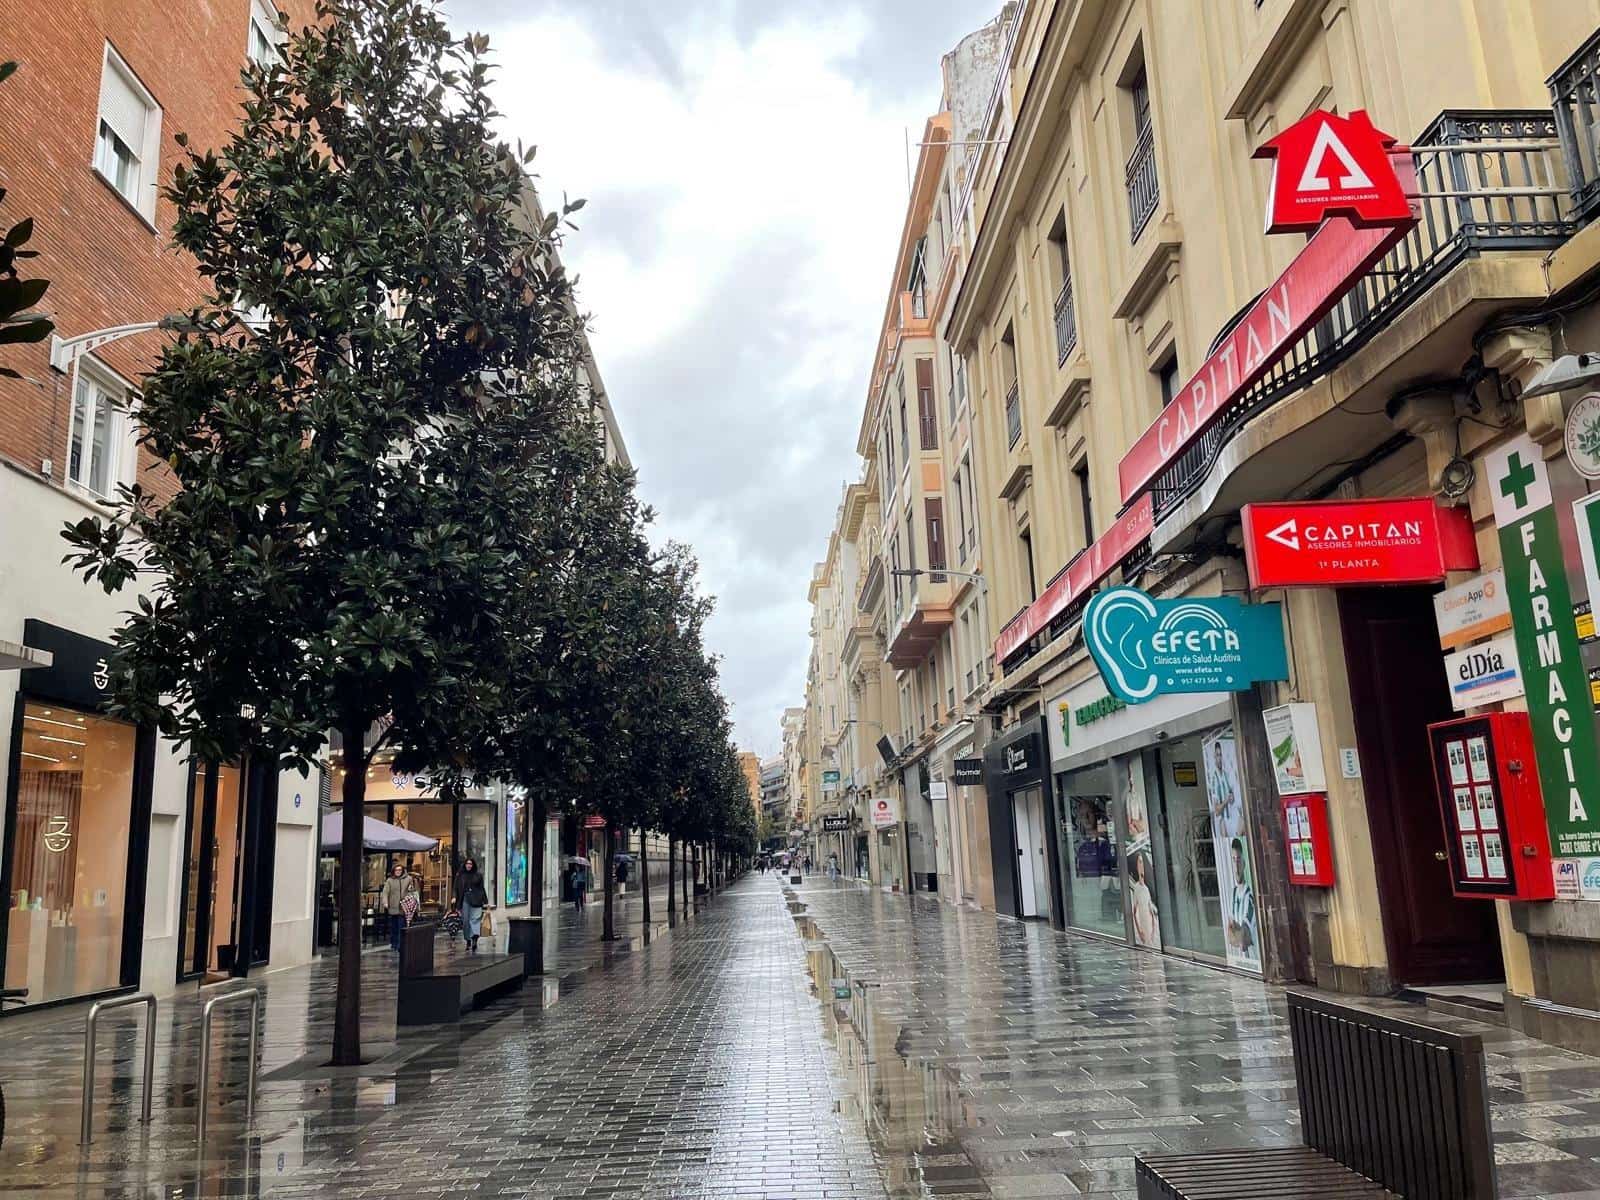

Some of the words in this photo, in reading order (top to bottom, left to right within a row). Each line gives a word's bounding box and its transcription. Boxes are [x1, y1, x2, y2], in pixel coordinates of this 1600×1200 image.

[1158, 283, 1291, 456] CAPITAN
[1304, 520, 1421, 542] CAPITAN
[1307, 541, 1353, 550] ASESORES
[1354, 538, 1422, 547] INMOBILIARIOS
[1332, 559, 1380, 568] PLANTA
[1151, 629, 1240, 653] EFETA
[1182, 655, 1192, 664] de
[1192, 654, 1212, 664] Salud
[1213, 653, 1241, 663] Auditiva
[1520, 521, 1588, 823] FARMACIA
